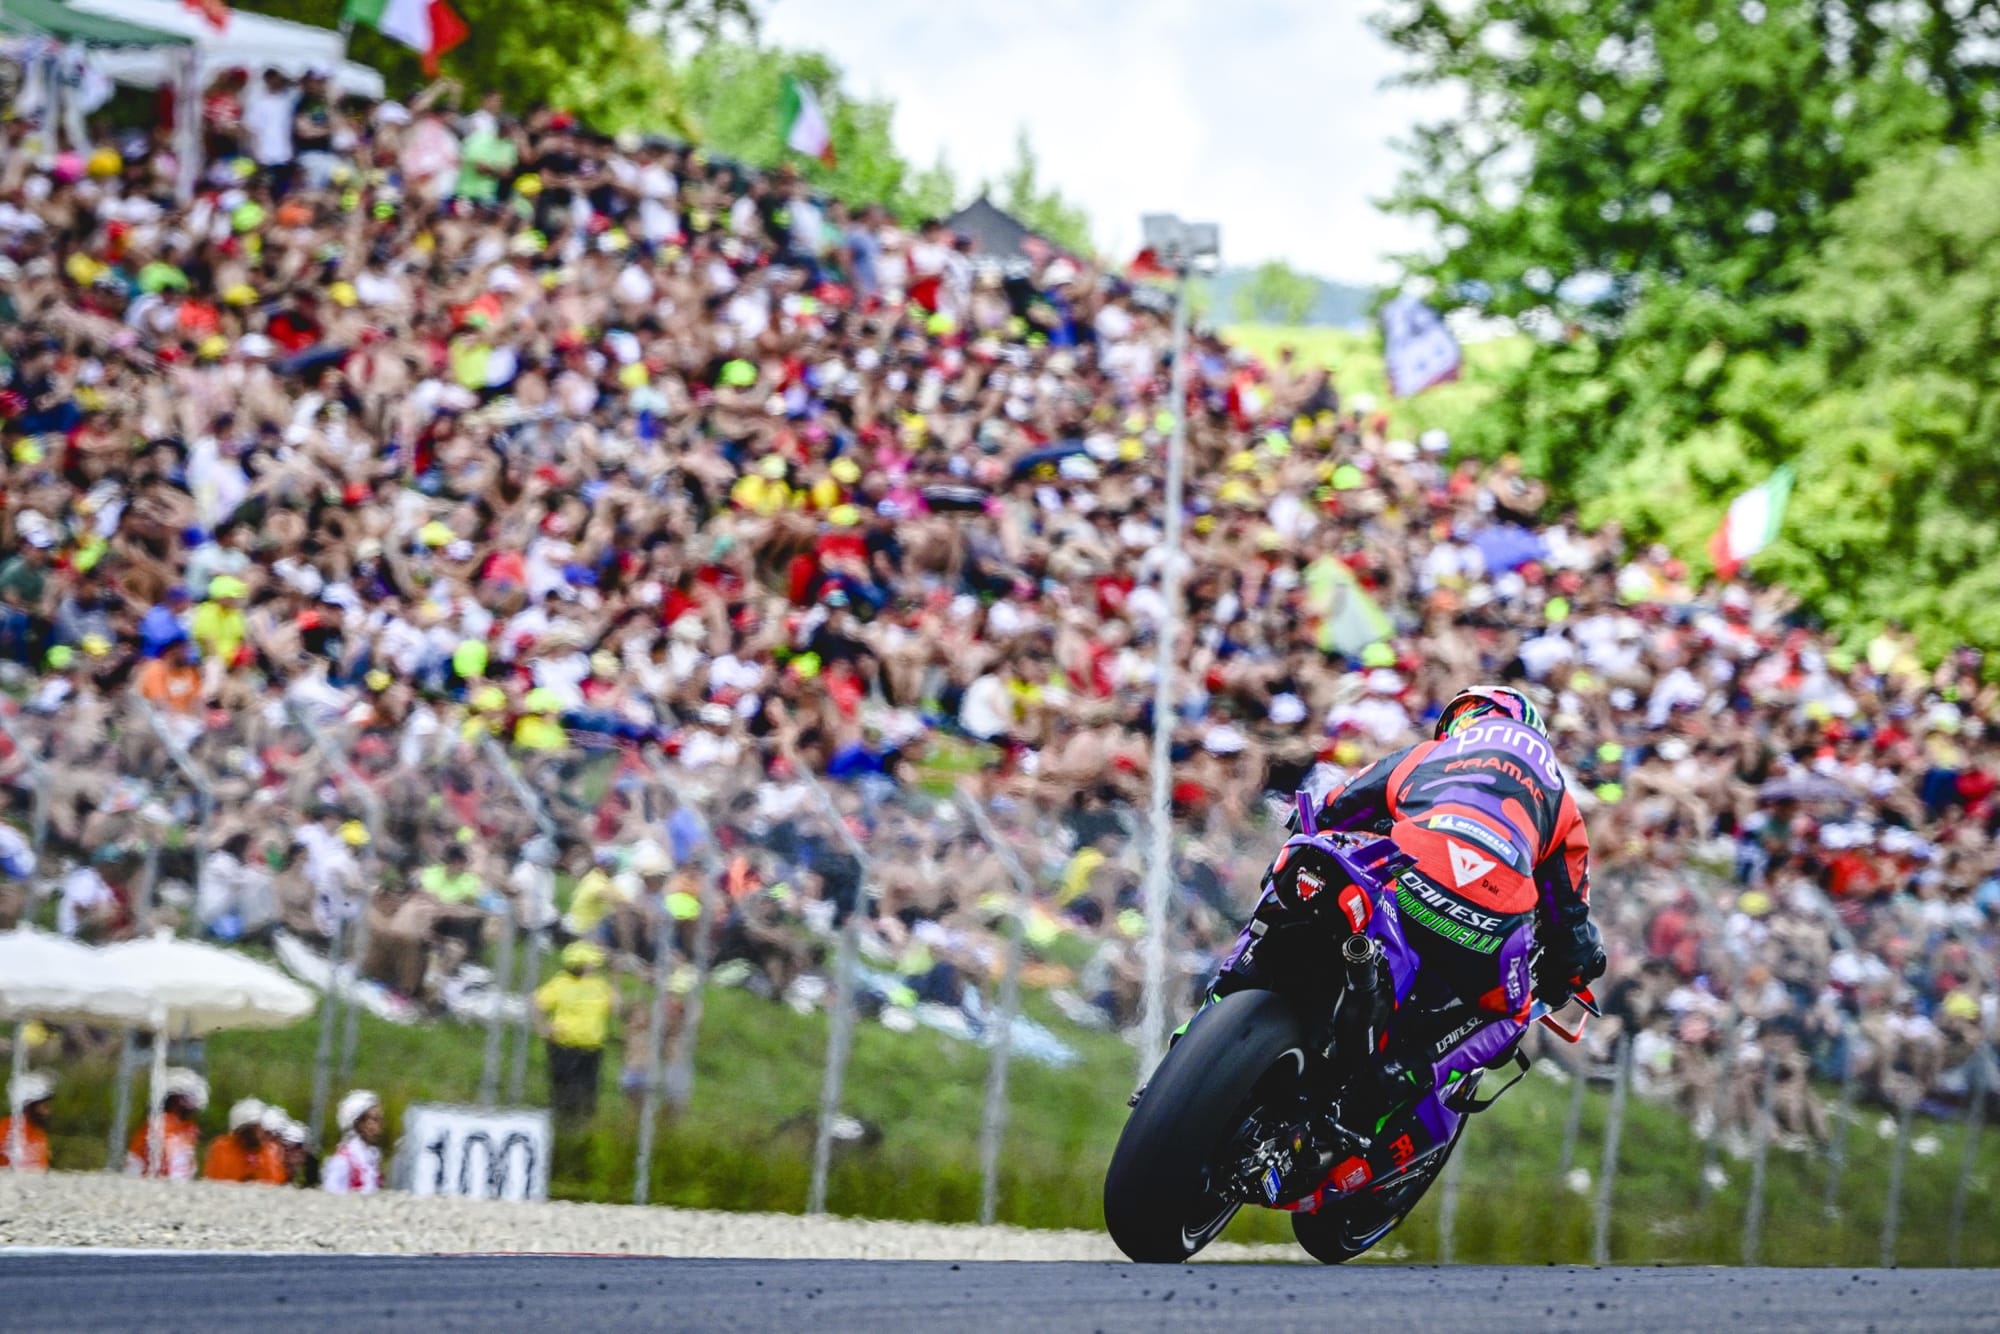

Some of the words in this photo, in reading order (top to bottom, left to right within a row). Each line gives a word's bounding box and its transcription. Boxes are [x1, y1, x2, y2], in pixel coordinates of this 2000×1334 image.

[1444, 757, 1545, 807] PRAMAC
[1455, 820, 1512, 856] MICHELIN
[1400, 871, 1502, 932] DAINESE
[425, 1130, 536, 1199] 100
